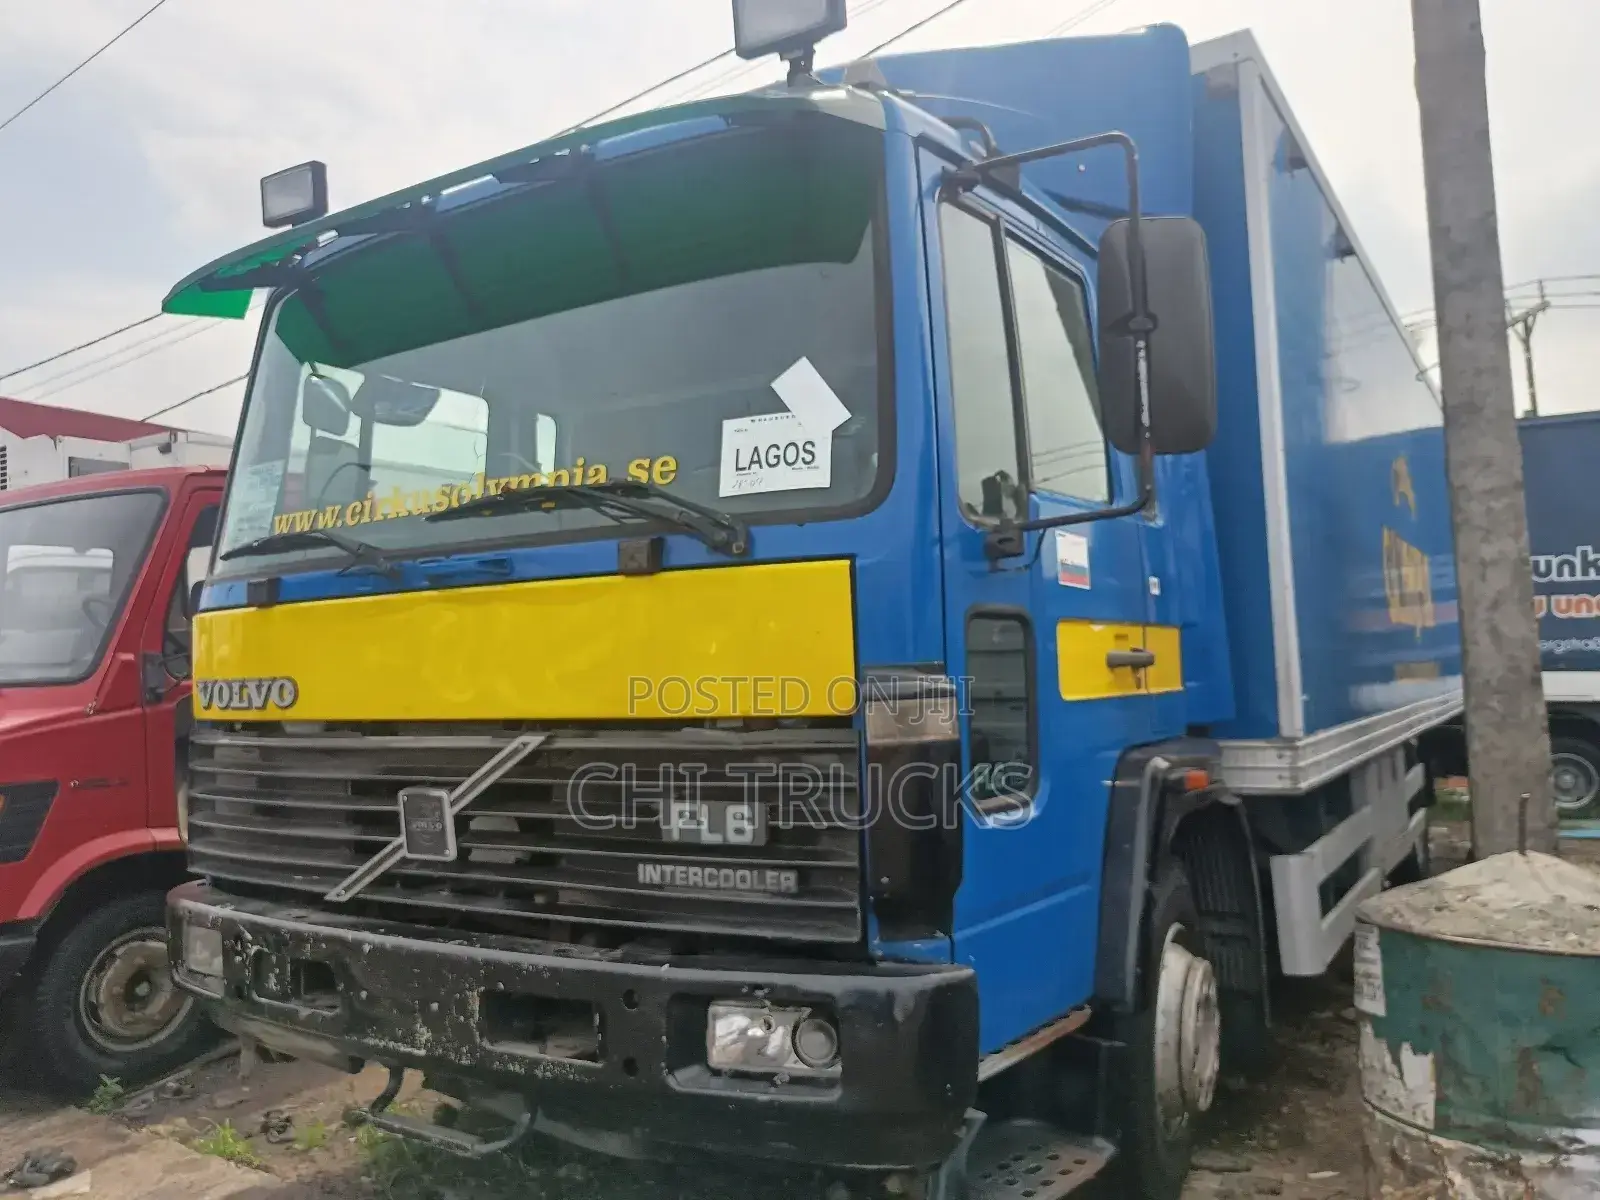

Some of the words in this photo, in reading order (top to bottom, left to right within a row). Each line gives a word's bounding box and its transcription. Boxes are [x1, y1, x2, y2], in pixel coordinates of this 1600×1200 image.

[735, 440, 817, 472] LAGOS
[196, 676, 299, 710] VOLVO
[671, 801, 754, 845] FL6
[637, 862, 799, 894] INTERCOOLER
